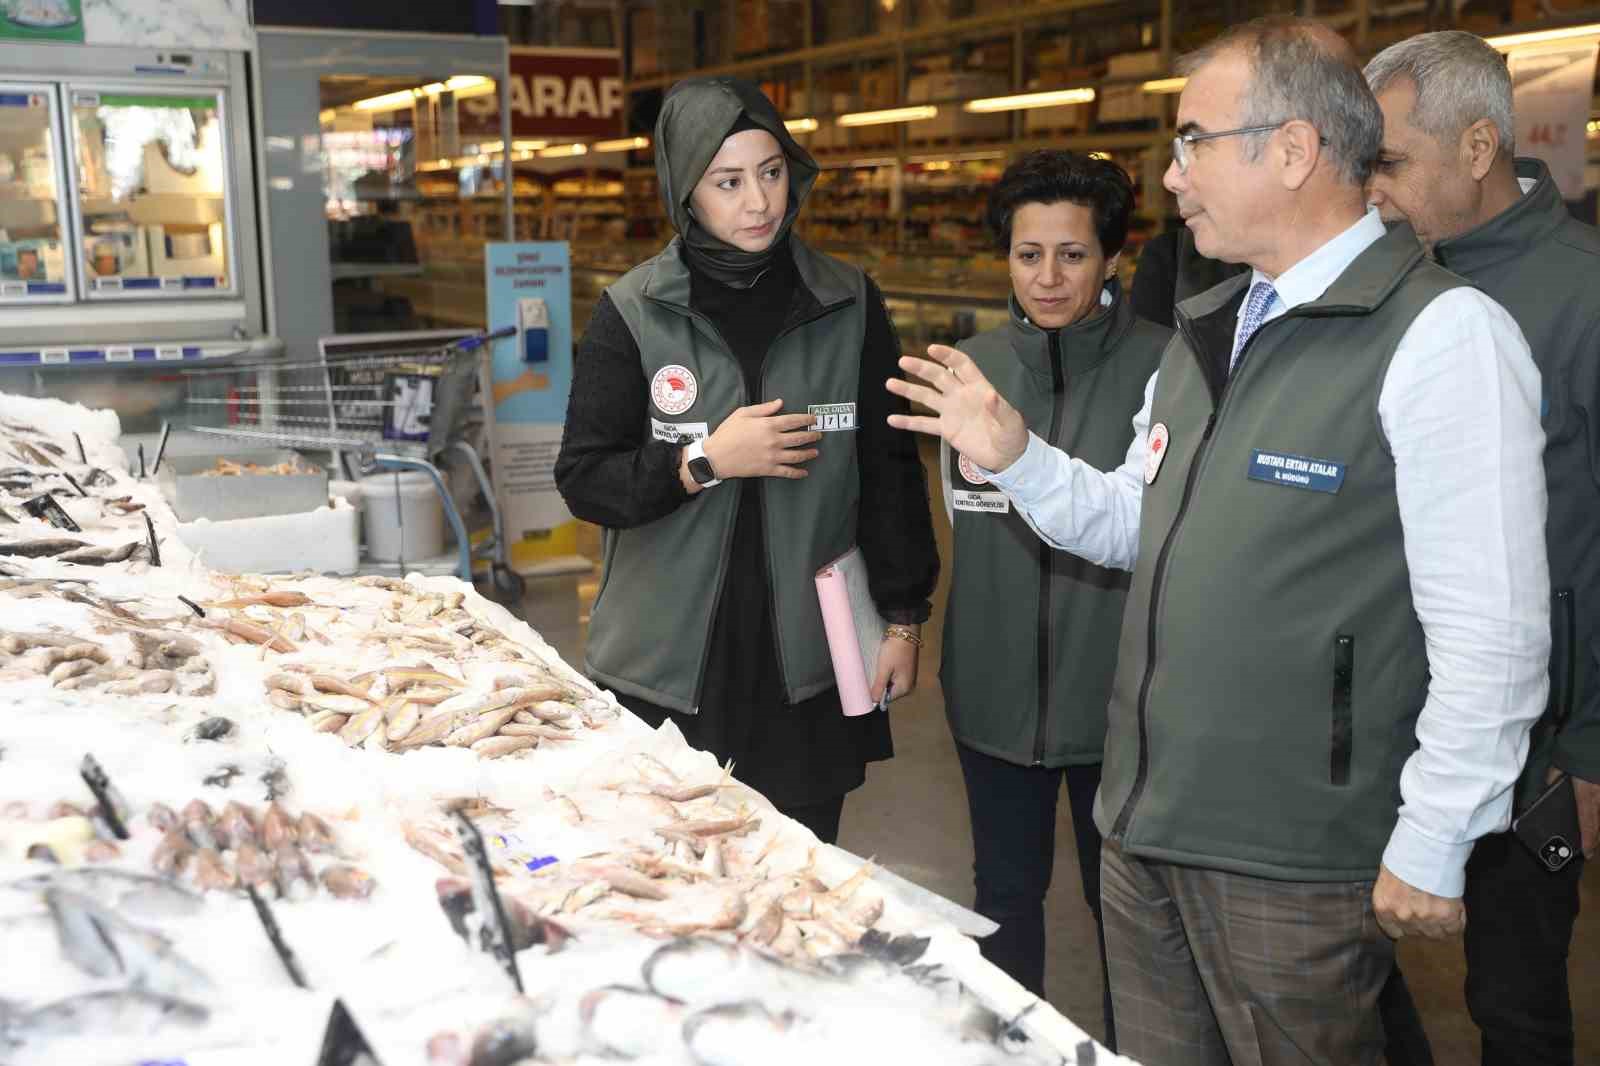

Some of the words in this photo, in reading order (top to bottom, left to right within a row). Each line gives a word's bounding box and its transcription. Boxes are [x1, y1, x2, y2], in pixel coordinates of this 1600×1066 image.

[1256, 454, 1285, 468] MUSTAFA
[1285, 458, 1309, 472] ERTAN
[1309, 462, 1338, 477] ATALAR
